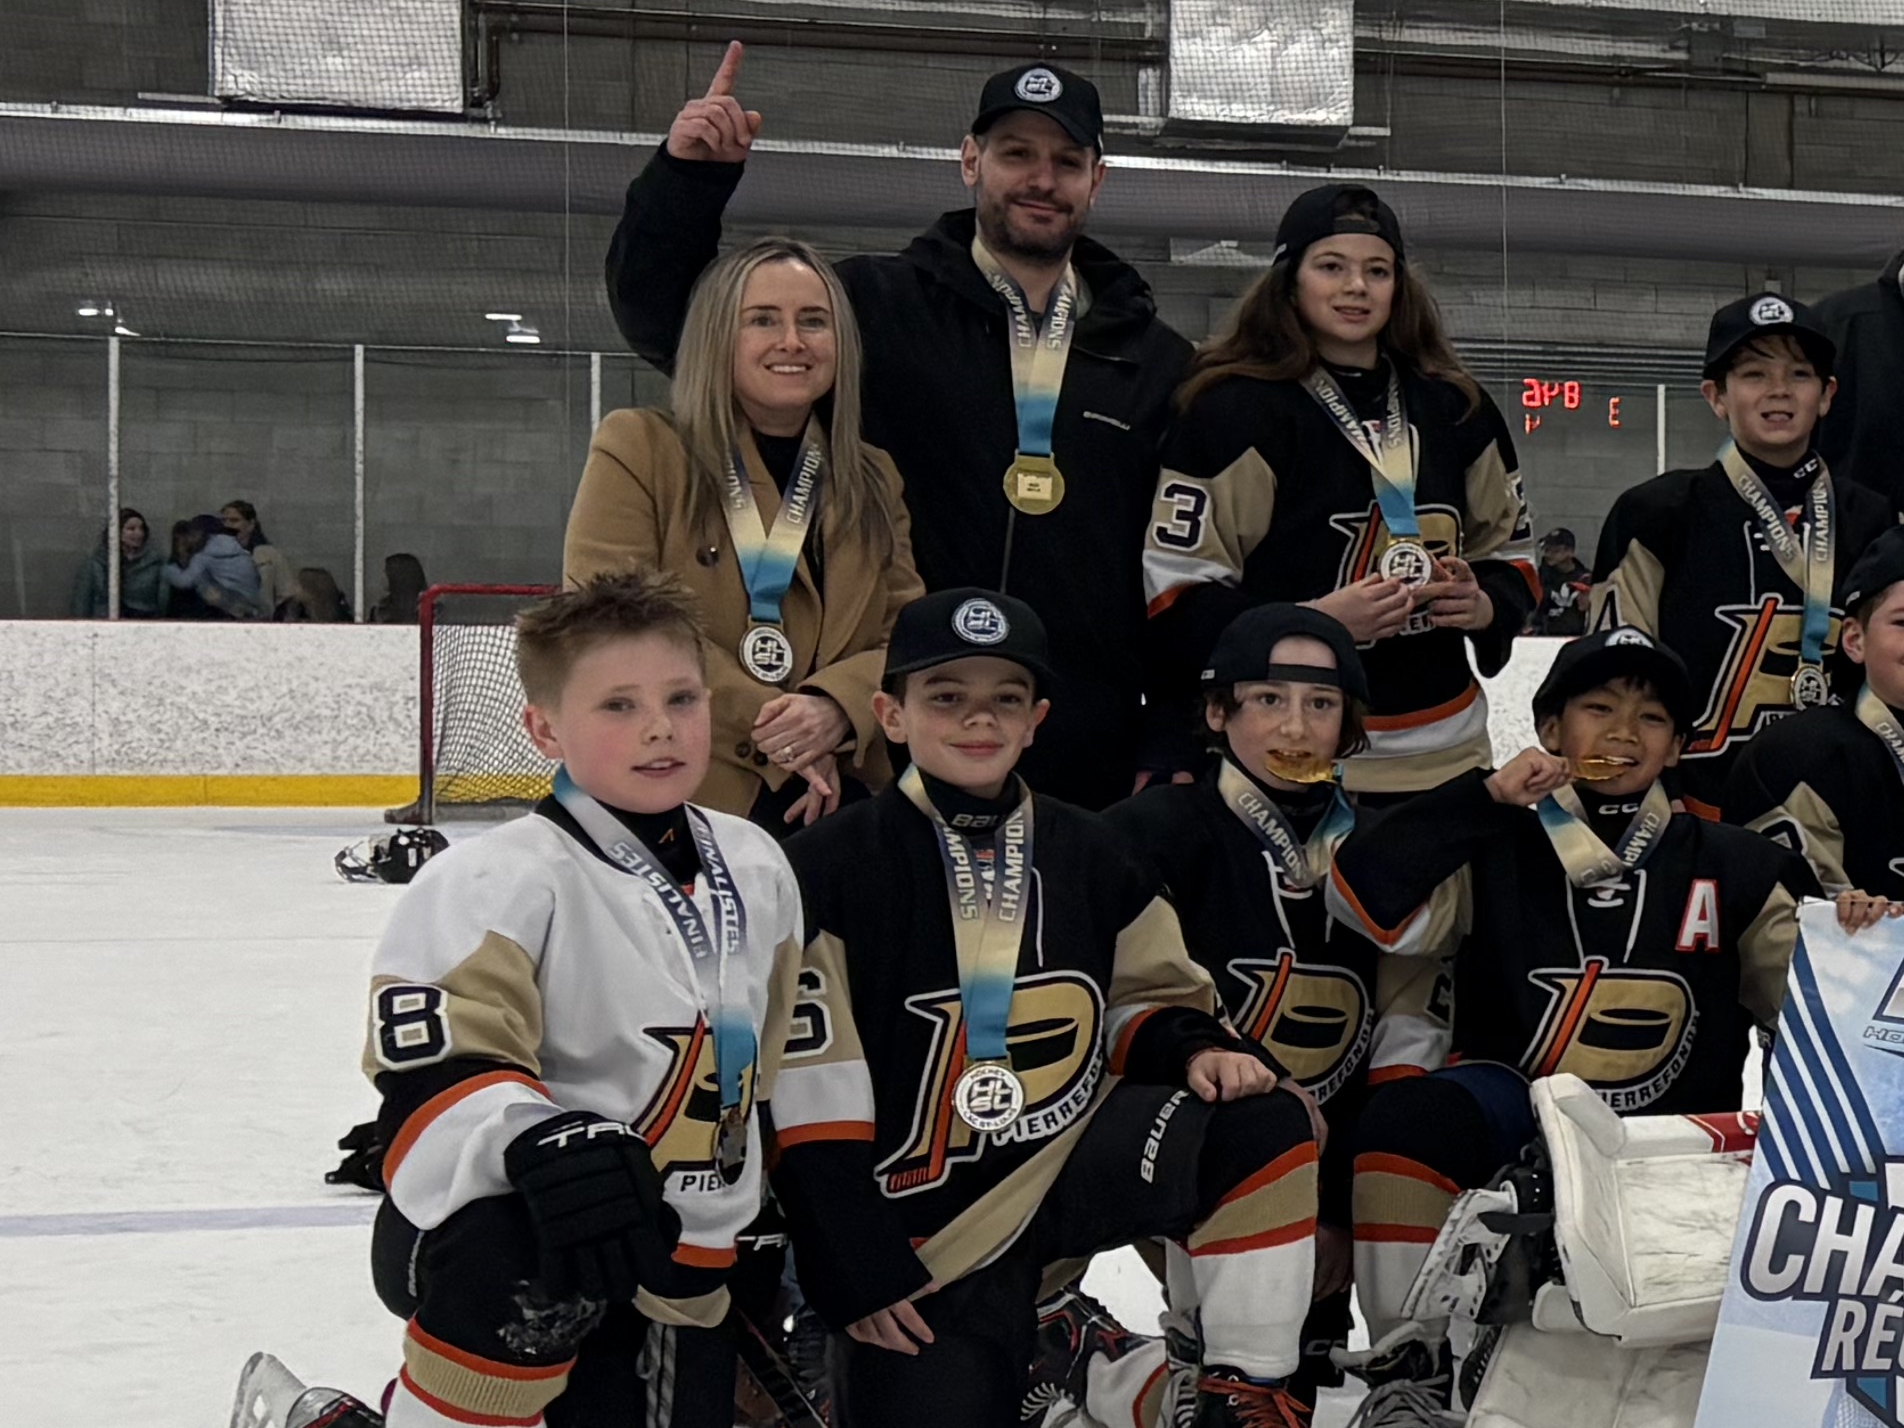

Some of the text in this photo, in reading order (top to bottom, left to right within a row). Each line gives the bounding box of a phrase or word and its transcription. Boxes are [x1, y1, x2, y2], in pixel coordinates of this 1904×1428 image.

[1155, 480, 1209, 553] 3
[1738, 475, 1795, 560] CHAMPIONS
[999, 811, 1025, 922] CHAMPION
[1674, 878, 1721, 952] A
[373, 983, 454, 1070] 8
